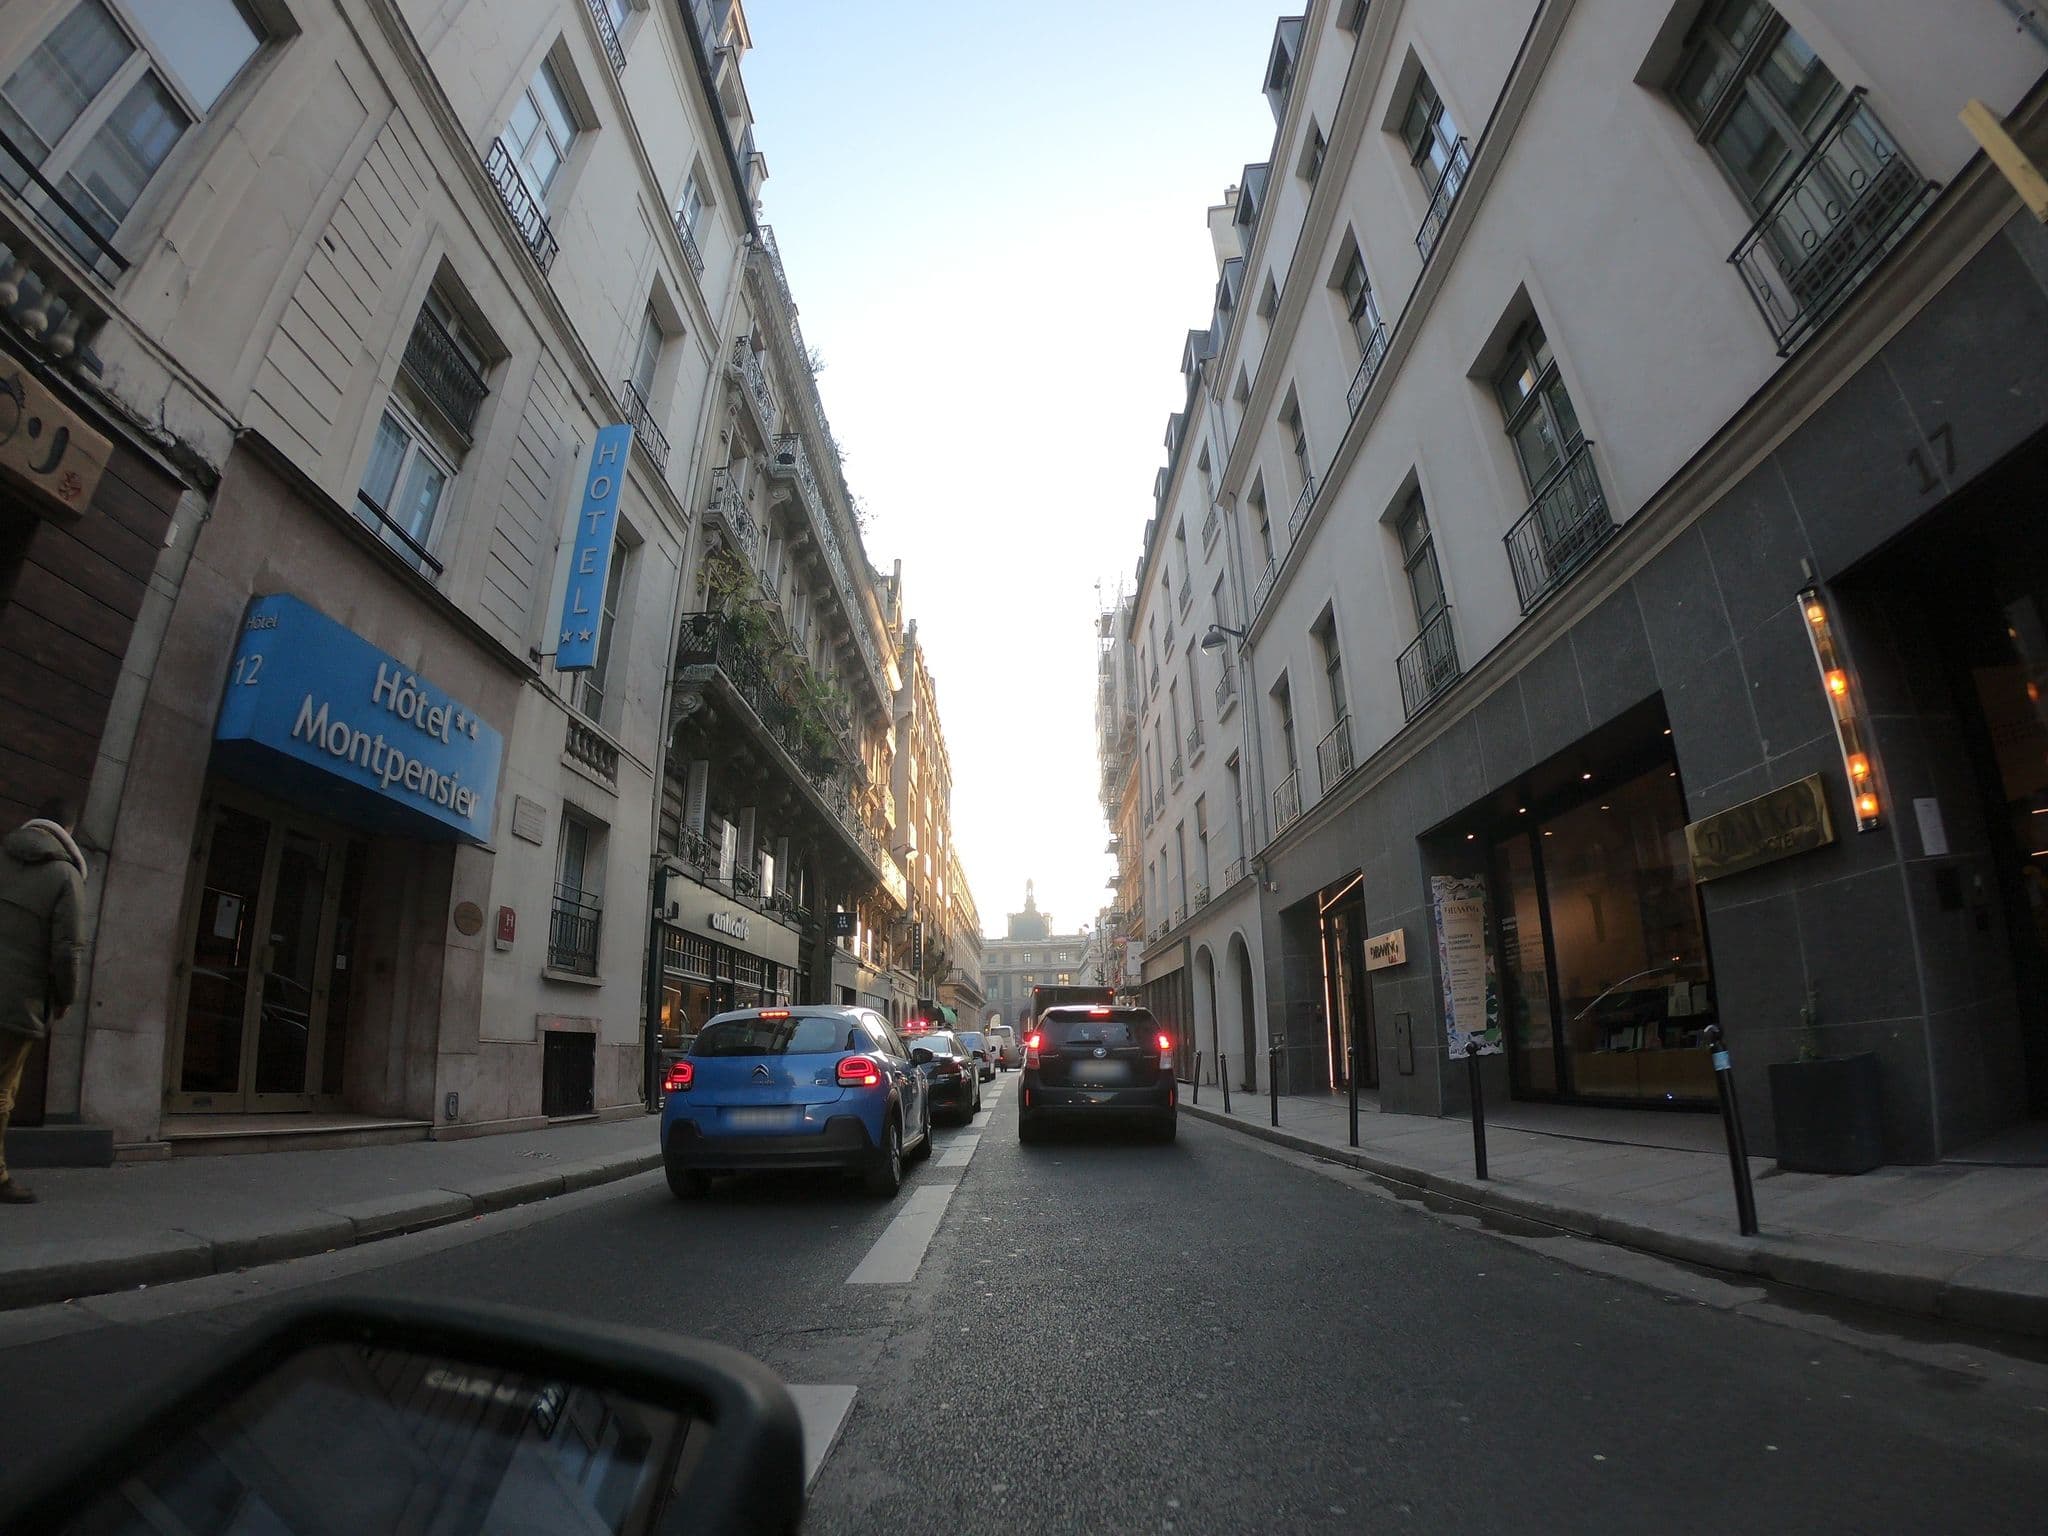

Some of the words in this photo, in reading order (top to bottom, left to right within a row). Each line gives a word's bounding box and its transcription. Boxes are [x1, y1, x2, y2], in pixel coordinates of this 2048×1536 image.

[1907, 421, 1957, 495] 17
[572, 441, 619, 615] HOTEL
[235, 654, 264, 685] 12
[372, 662, 453, 745] Hôtel
[291, 694, 480, 819] Montpensier
[712, 911, 751, 941] anticafé
